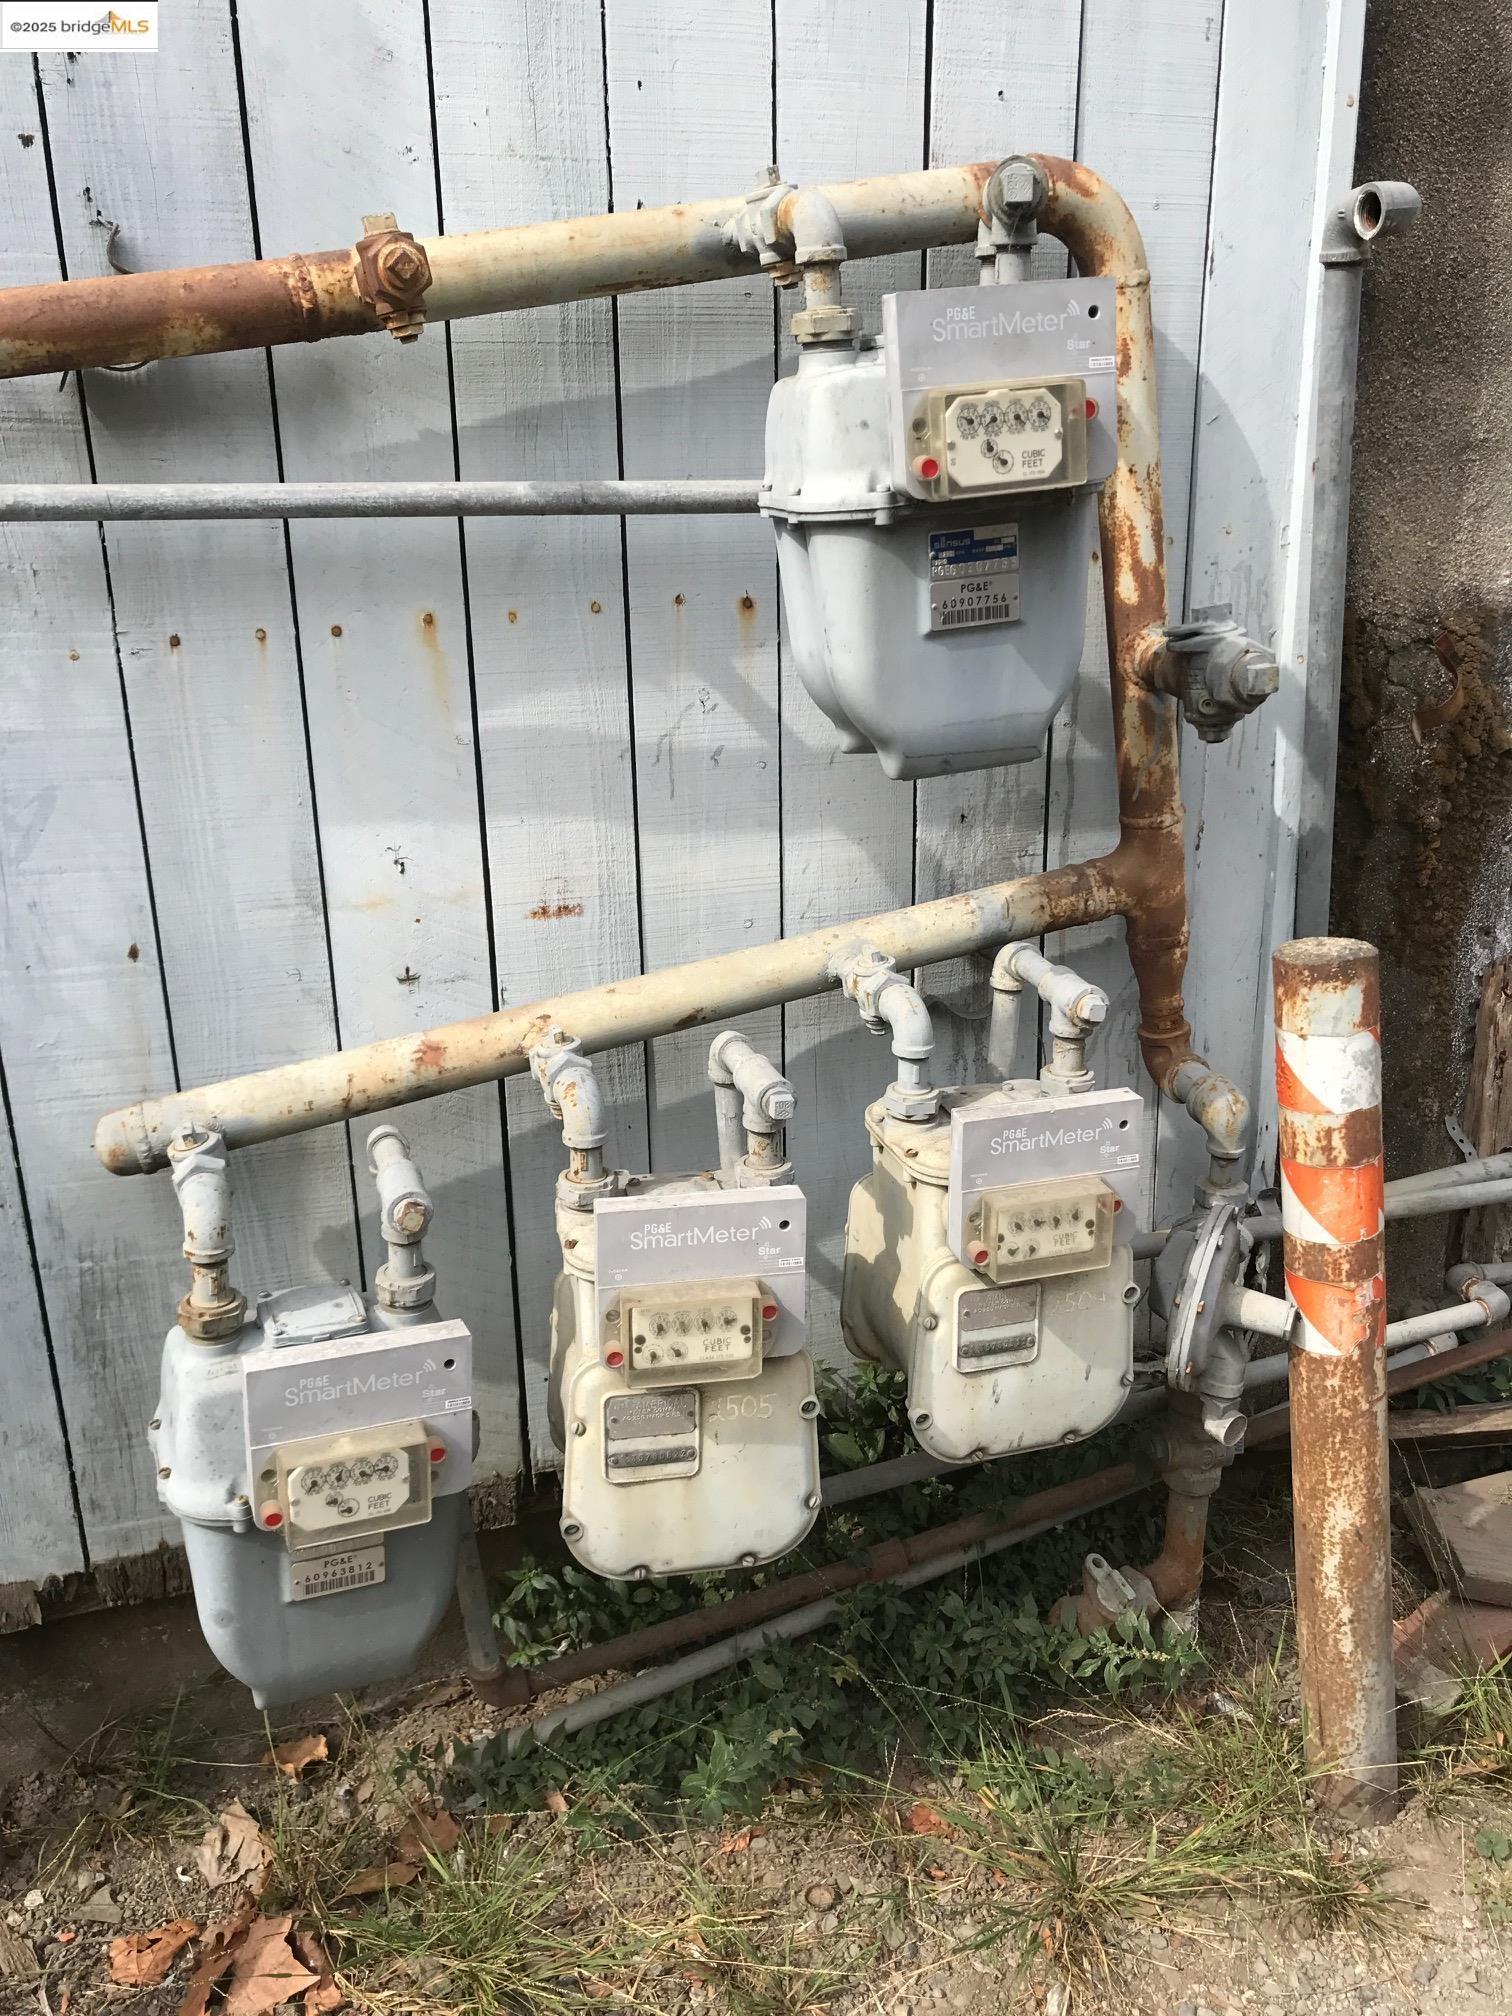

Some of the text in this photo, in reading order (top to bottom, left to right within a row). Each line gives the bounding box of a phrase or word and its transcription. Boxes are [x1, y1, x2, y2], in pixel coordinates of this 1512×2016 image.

[946, 306, 976, 321] PG&E
[932, 311, 1068, 342] SmartMeter
[1067, 338, 1091, 350] Star
[1022, 449, 1046, 458] CUBIC
[1022, 459, 1043, 468] FEET
[960, 581, 989, 593] PG&E
[942, 593, 1007, 610] 60907756
[1003, 1127, 1028, 1140] PG&E
[991, 1127, 1103, 1155] SmartMeter
[1099, 1143, 1120, 1154] Star
[644, 1222, 672, 1234] PG&E
[630, 1225, 760, 1250] SmartMeter
[1052, 1231, 1078, 1240] CUBIC
[1054, 1238, 1076, 1247] FEET
[758, 1245, 781, 1256] Star
[702, 1336, 732, 1345] CUBIC
[704, 1344, 730, 1352] FEET
[300, 1374, 329, 1389] PG&E
[284, 1369, 424, 1407] SmartMeter
[368, 1492, 392, 1502] CUBIC
[368, 1501, 390, 1511] FEET
[324, 1555, 353, 1568] PG&E
[305, 1562, 372, 1582] 60963812
